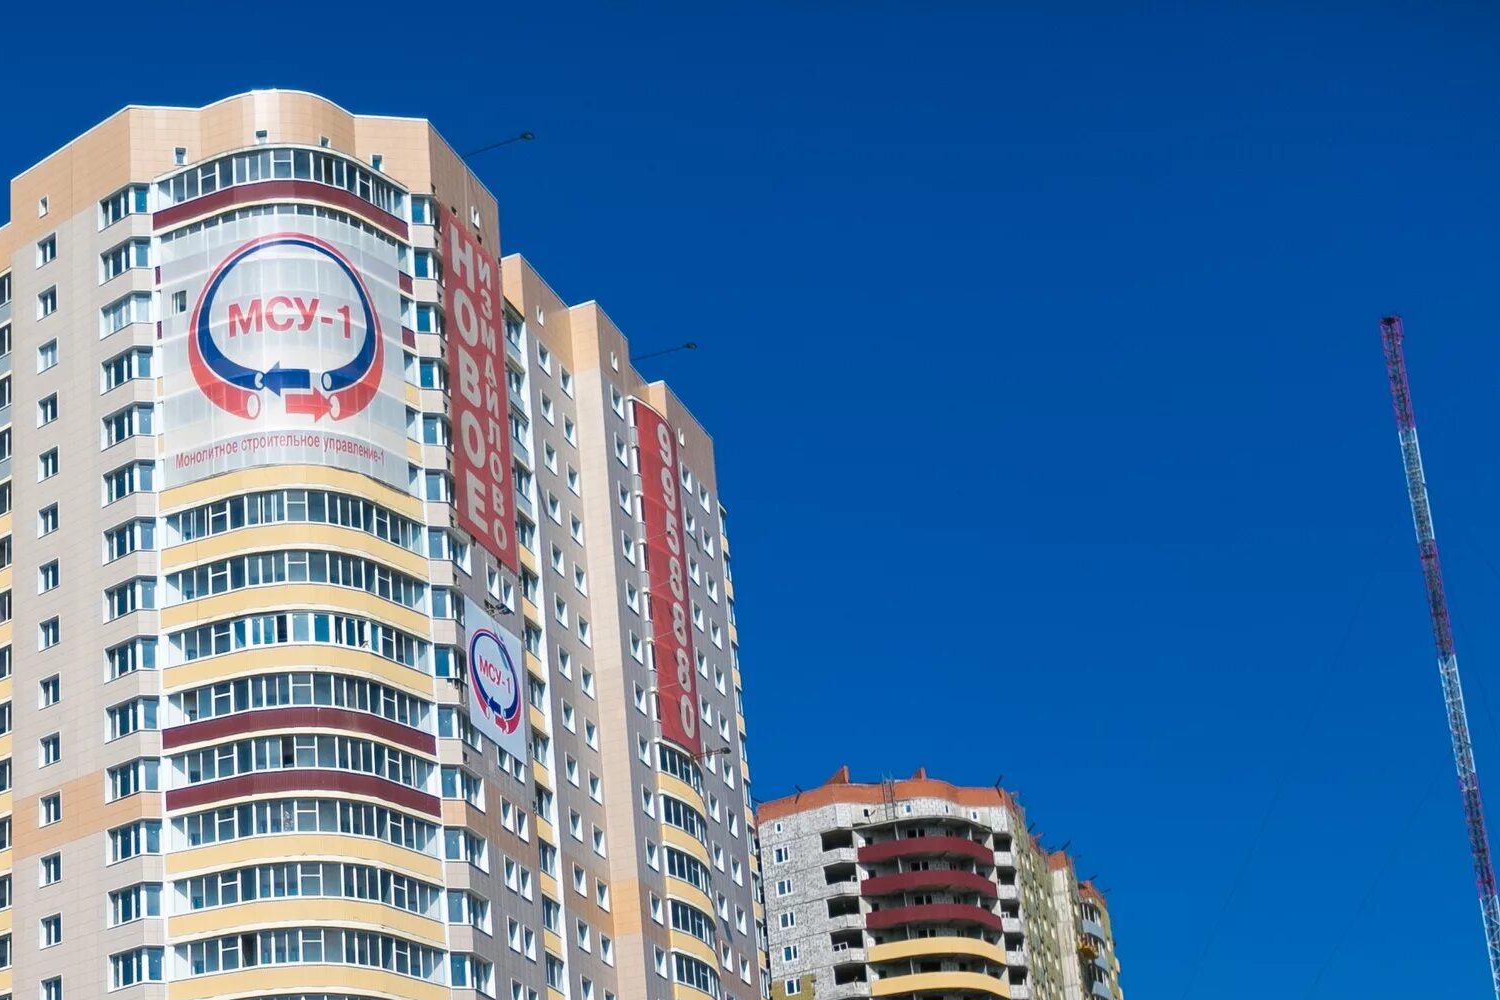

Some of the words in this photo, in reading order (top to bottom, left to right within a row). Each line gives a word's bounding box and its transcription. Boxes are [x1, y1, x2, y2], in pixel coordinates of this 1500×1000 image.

[228, 295, 352, 339] МСУ-1
[449, 222, 489, 535] НОВОЕ
[175, 442, 238, 469] Монолитное
[241, 433, 320, 453] строительное
[323, 437, 385, 464] управление-1
[657, 423, 695, 739] 9958880
[479, 655, 510, 693] МСУ-1
